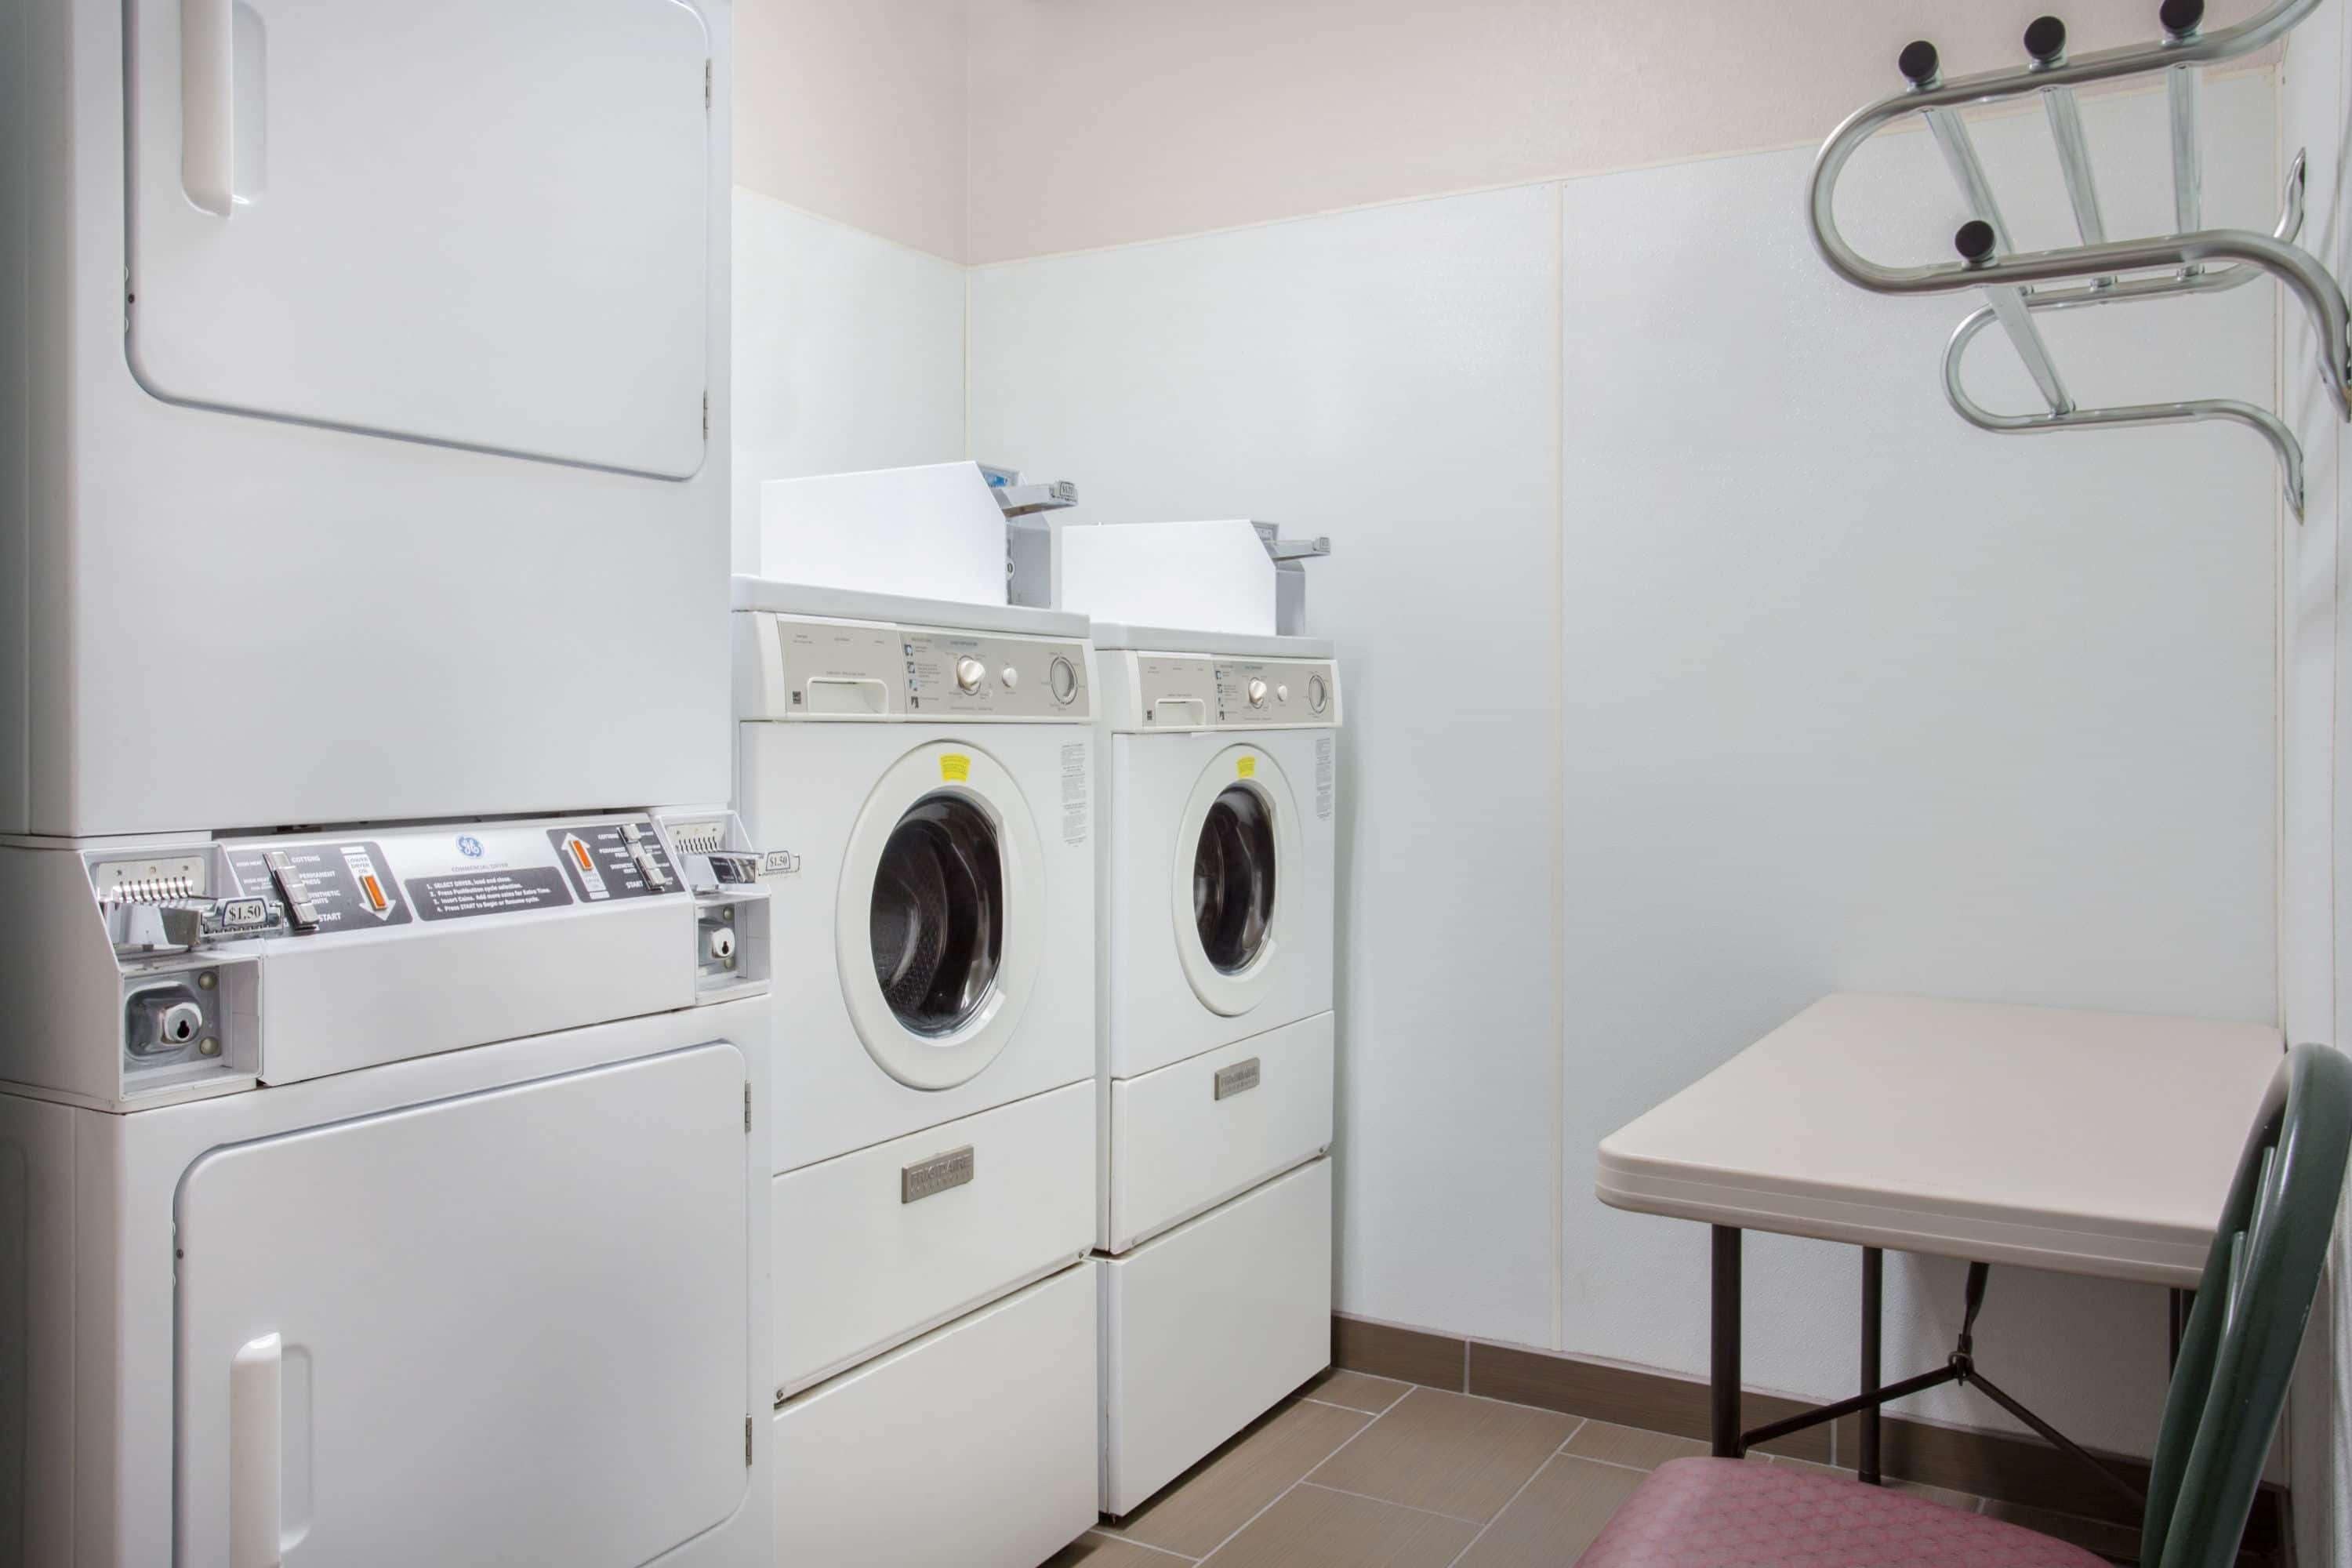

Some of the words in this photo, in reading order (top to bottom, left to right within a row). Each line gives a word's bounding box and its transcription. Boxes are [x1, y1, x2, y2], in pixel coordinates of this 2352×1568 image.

[769, 855, 787, 868] $1.50
[299, 870, 336, 879] PERMANENT
[229, 904, 261, 921] $1.50
[318, 912, 341, 923] START
